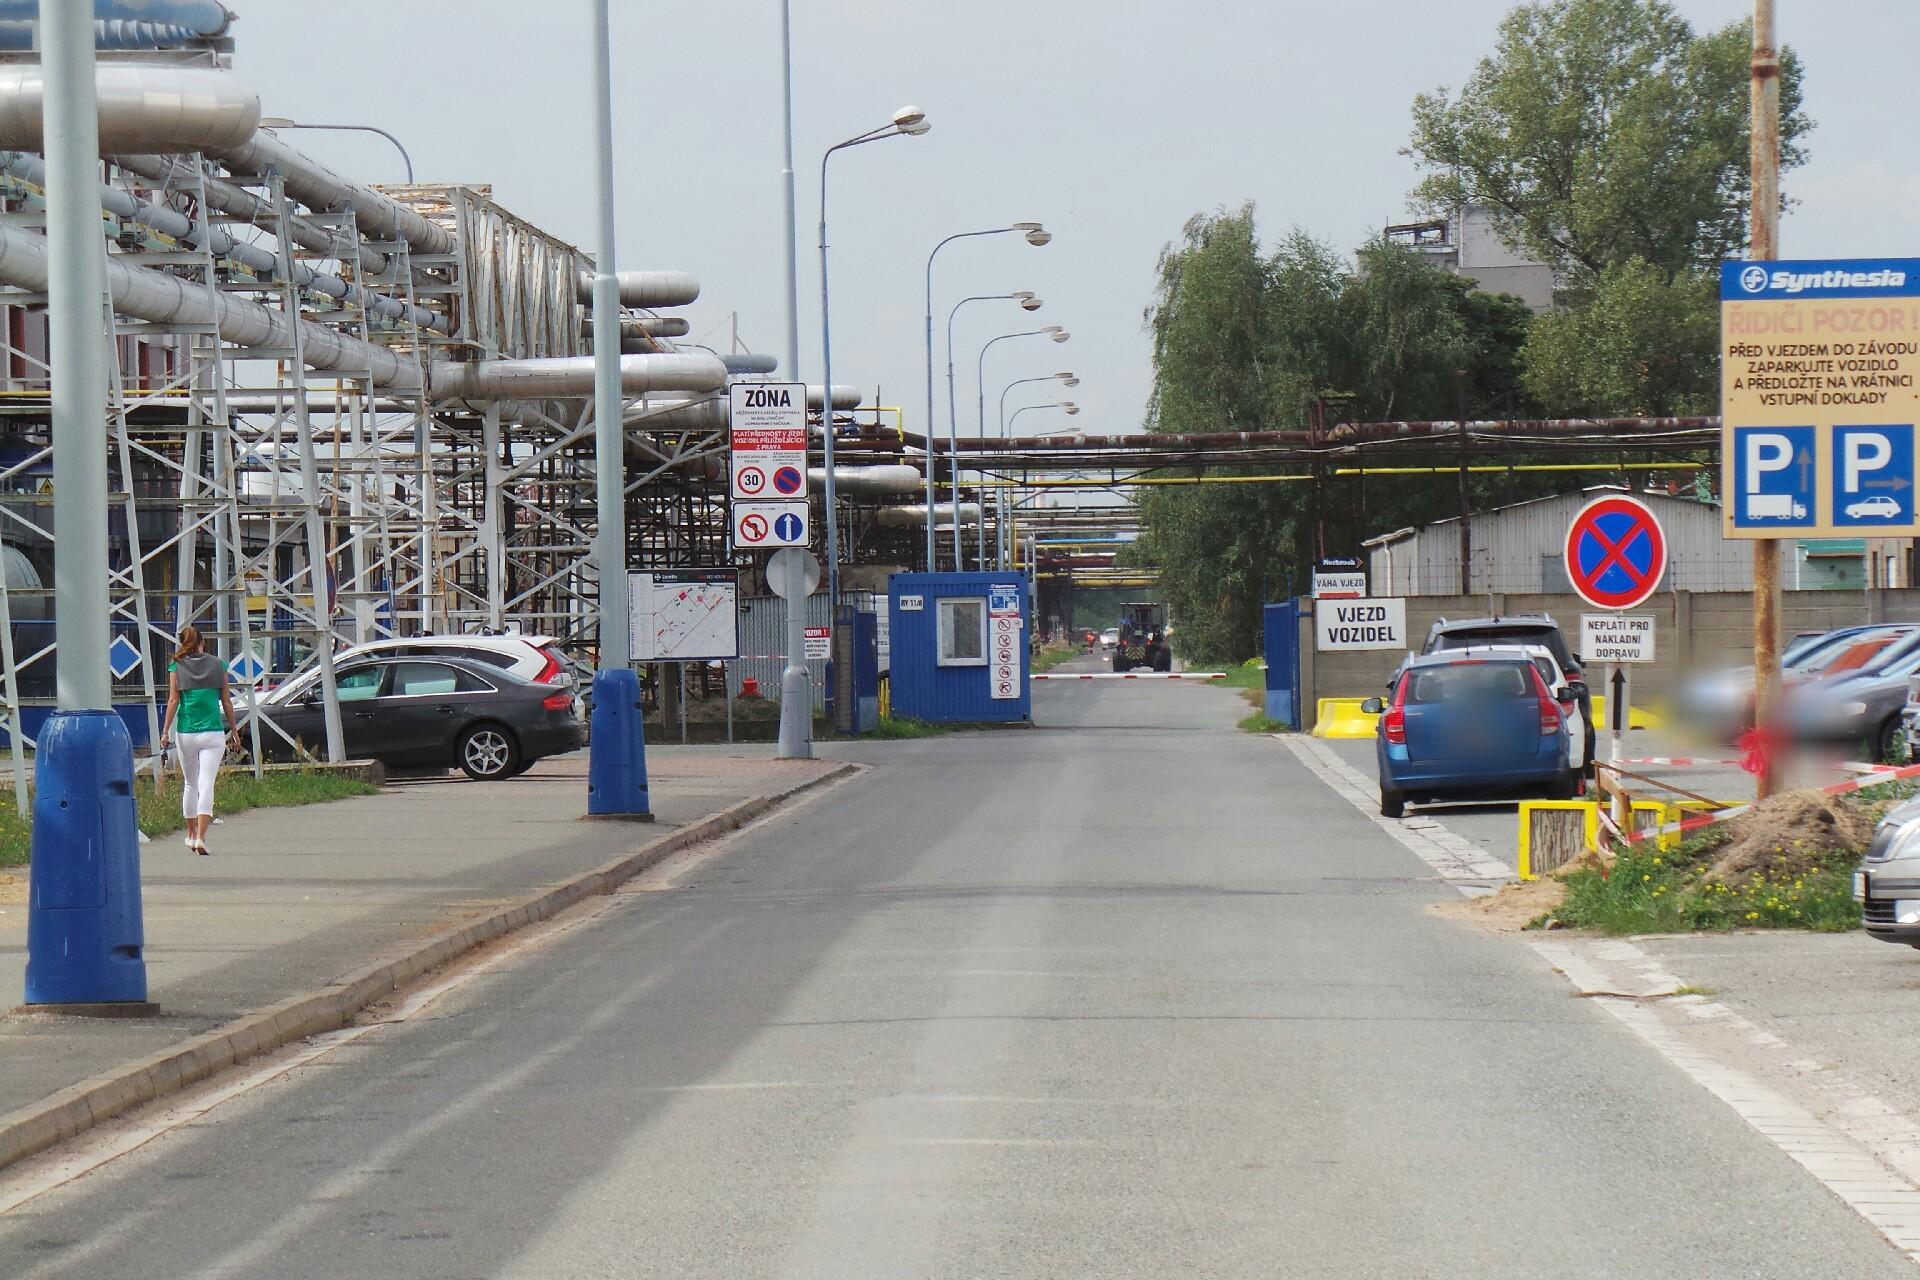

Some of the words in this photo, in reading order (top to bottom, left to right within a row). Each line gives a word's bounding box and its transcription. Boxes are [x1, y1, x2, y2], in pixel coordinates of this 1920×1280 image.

[1770, 269, 1906, 293] Synthesia
[1728, 303, 1803, 334] ŘIDIČI
[1813, 308, 1905, 334] POZOR
[1729, 342, 1763, 357] PŘED
[1767, 344, 1829, 357] VJEZDEM
[1834, 344, 1854, 356] DO
[1858, 340, 1918, 355] ZÁVODU
[1747, 360, 1834, 373] ZAPARKUJTE
[1838, 359, 1899, 372] VOZIDLO
[1734, 377, 1744, 390] A
[1748, 373, 1823, 390] PŘEDLOŽTE
[1827, 376, 1847, 388] NA
[1851, 373, 1913, 388] VRÁTNICI
[745, 385, 791, 407] ZÓNA
[1760, 390, 1819, 405] VSTUPNÍ
[1822, 392, 1888, 405] DOKLADY
[1747, 433, 1794, 493] P
[1845, 432, 1892, 493] P
[744, 474, 759, 486] 30
[1340, 578, 1364, 587] VJEZD
[1336, 606, 1386, 623] VJEZD
[805, 629, 822, 637] OZOR
[1328, 626, 1398, 643] VOZIDEL
[1630, 621, 1649, 631] PRO
[1596, 648, 1640, 658] DOPRAVU
